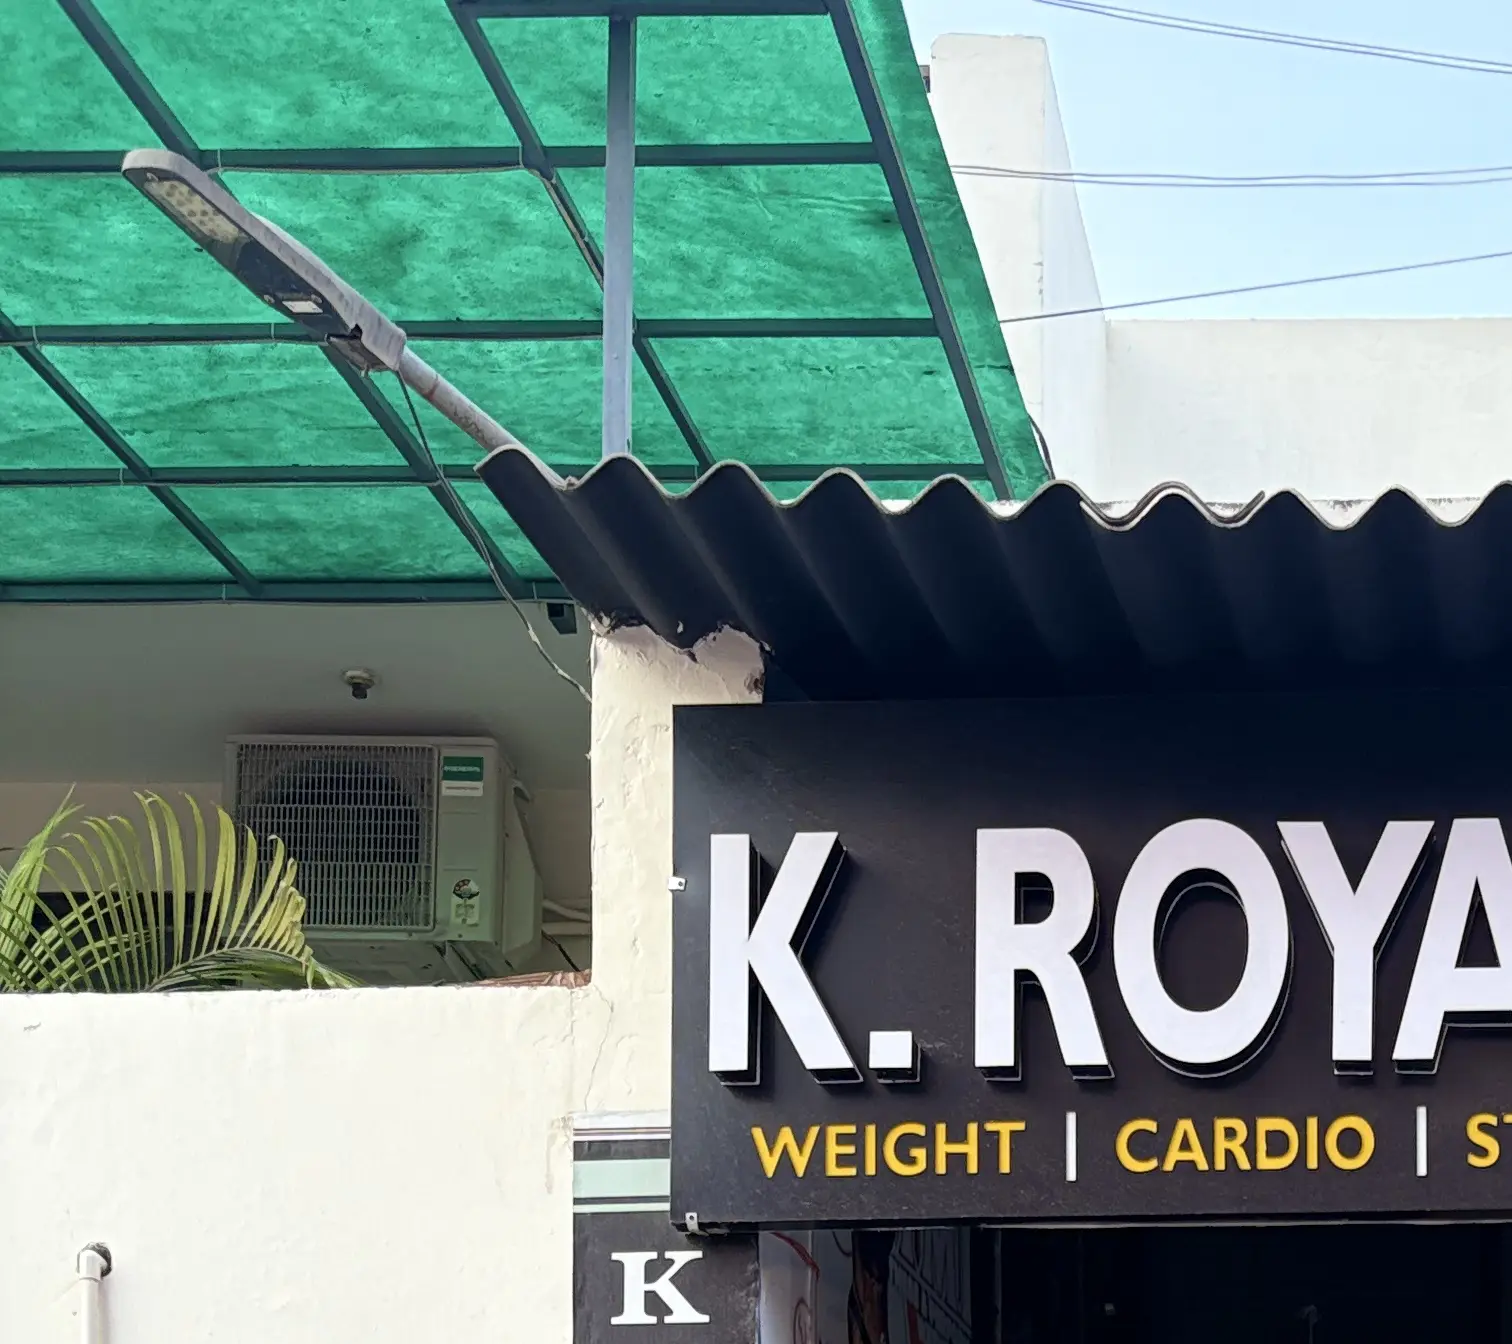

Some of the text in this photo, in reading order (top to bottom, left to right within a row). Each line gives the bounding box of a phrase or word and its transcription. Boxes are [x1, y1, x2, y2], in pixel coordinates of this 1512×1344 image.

[707, 830, 914, 1074] K.
[750, 1119, 1026, 1177] WEIGHT
[1115, 1113, 1377, 1173] CARDIO
[609, 1249, 711, 1326] K
